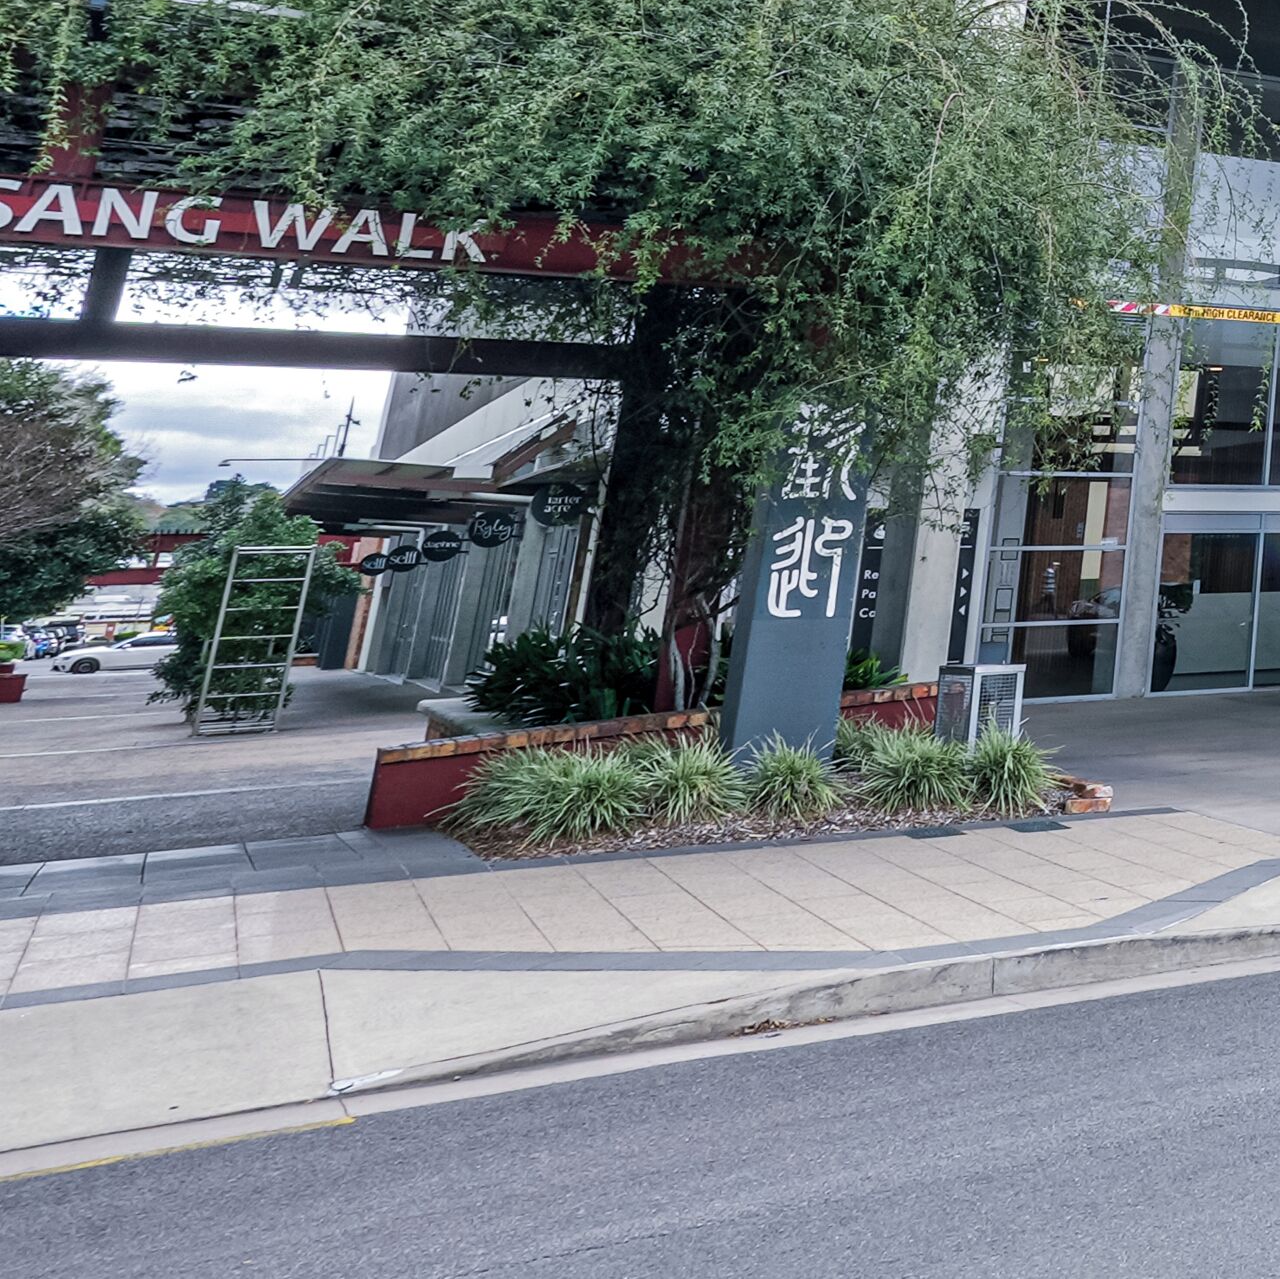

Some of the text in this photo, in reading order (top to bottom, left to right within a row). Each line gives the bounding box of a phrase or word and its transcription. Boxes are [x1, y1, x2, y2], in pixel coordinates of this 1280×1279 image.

[0, 178, 486, 263] SANG WALK
[1227, 309, 1276, 322] CLEARANCE
